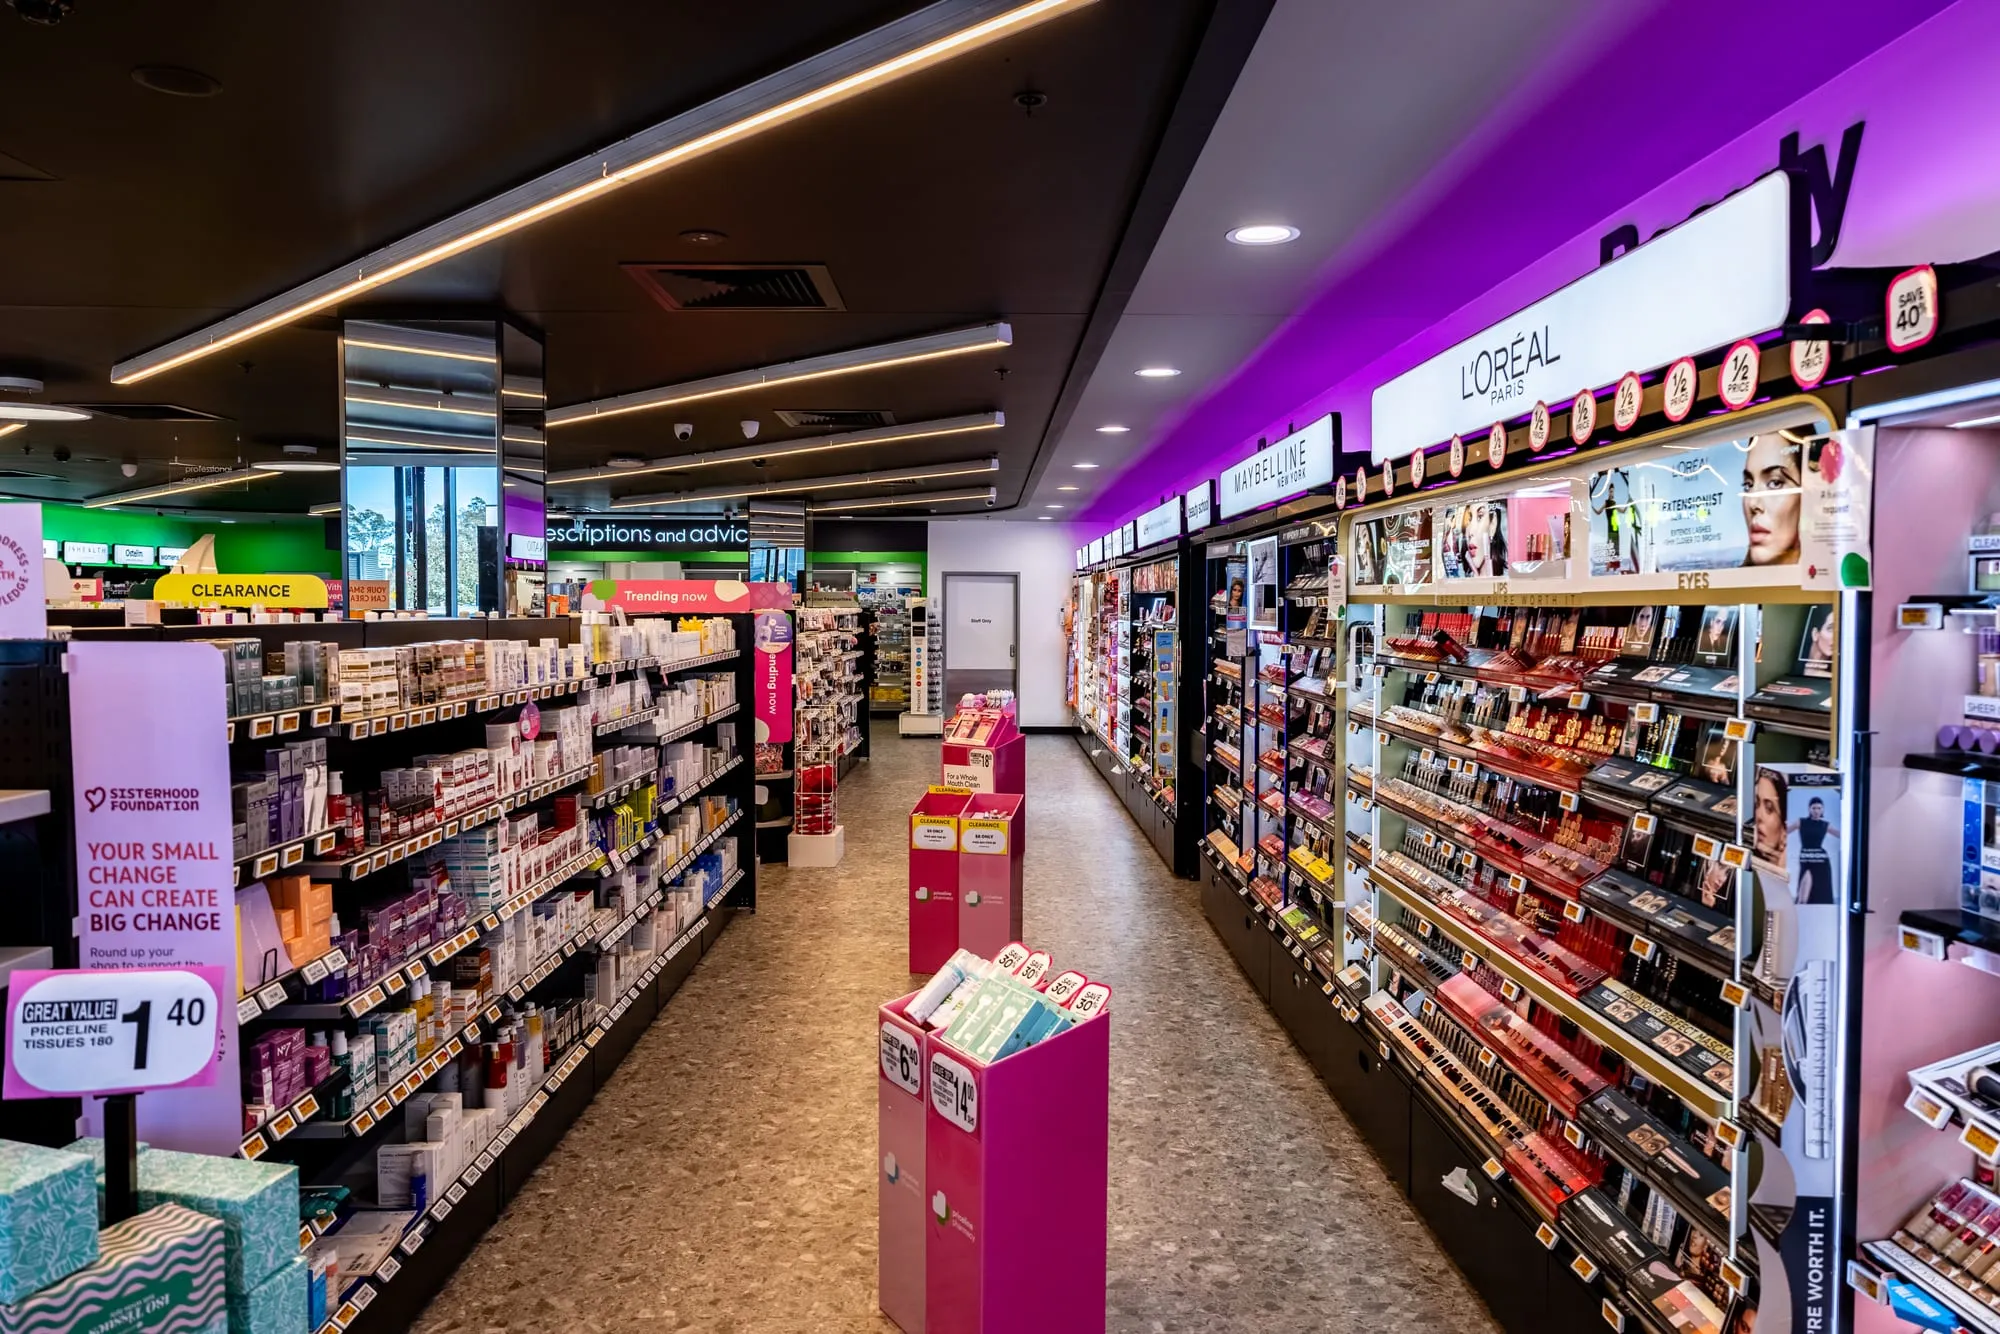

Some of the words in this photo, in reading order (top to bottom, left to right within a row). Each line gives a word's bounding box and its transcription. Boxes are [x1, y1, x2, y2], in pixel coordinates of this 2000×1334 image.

[1899, 287, 1924, 308] SAVE
[1462, 325, 1560, 400] L'ORÉAL
[1733, 353, 1749, 382] 1/2
[1801, 354, 1823, 369] PRICE
[1673, 368, 1687, 396] 1/2
[1728, 382, 1750, 393] PRICE
[1621, 382, 1633, 408] 1/2
[1670, 392, 1688, 407] PRICE
[1577, 398, 1588, 422] 1/2
[1617, 406, 1634, 417] PRICE
[185, 465, 232, 473] professional
[1234, 439, 1306, 494] MAYBELLINE
[1277, 474, 1289, 489] NEW
[1290, 467, 1306, 483] YORK
[1662, 492, 1723, 511] EXTENSIONIST
[655, 529, 686, 542] and
[1493, 582, 1508, 594] LIPS
[1678, 573, 1709, 589] EYES
[191, 583, 290, 598] CLEARANCE
[624, 590, 678, 603] Trending
[682, 592, 707, 602] now
[1521, 594, 1557, 604] WORTH
[769, 692, 777, 714] now
[1968, 702, 1993, 714] SHEER
[982, 754, 990, 768] 18
[947, 780, 964, 788] Mouth
[960, 774, 978, 782] Whole
[110, 788, 199, 799] SISTERHOOD
[110, 801, 200, 811] FOUNDATION
[88, 842, 145, 861] YOUR
[152, 842, 219, 860] SMALL
[88, 866, 177, 884] CHANGE
[89, 890, 135, 908] CAN
[141, 889, 218, 907] CREATE
[90, 913, 127, 932] BIG
[133, 913, 221, 931] CHANGE
[90, 947, 127, 957] Round
[131, 949, 145, 960] up
[149, 948, 174, 960] your
[1008, 949, 1023, 962] SAVE
[1029, 959, 1044, 971] SAVE
[1062, 977, 1078, 988] SAVE
[1084, 991, 1102, 1002] SAVE
[24, 1002, 68, 1021] GREAT
[70, 1000, 117, 1019] VALUE!
[167, 997, 205, 1026] 40
[1621, 988, 1640, 1002] FIND
[1640, 998, 1662, 1015] YOUR
[1660, 1009, 1698, 1038] PERFECT
[30, 1024, 107, 1036] PRICELINE
[122, 1000, 151, 1070] 1
[24, 1037, 85, 1049] TISSUES
[90, 1036, 113, 1046] 180
[900, 1044, 909, 1081] 6
[954, 1076, 968, 1121] 14
[952, 1209, 974, 1230] priceline
[1809, 1208, 1825, 1227] IT.
[952, 1219, 976, 1243] pharmacy
[1807, 1233, 1824, 1301] WORTH
[146, 1293, 170, 1314] 180
